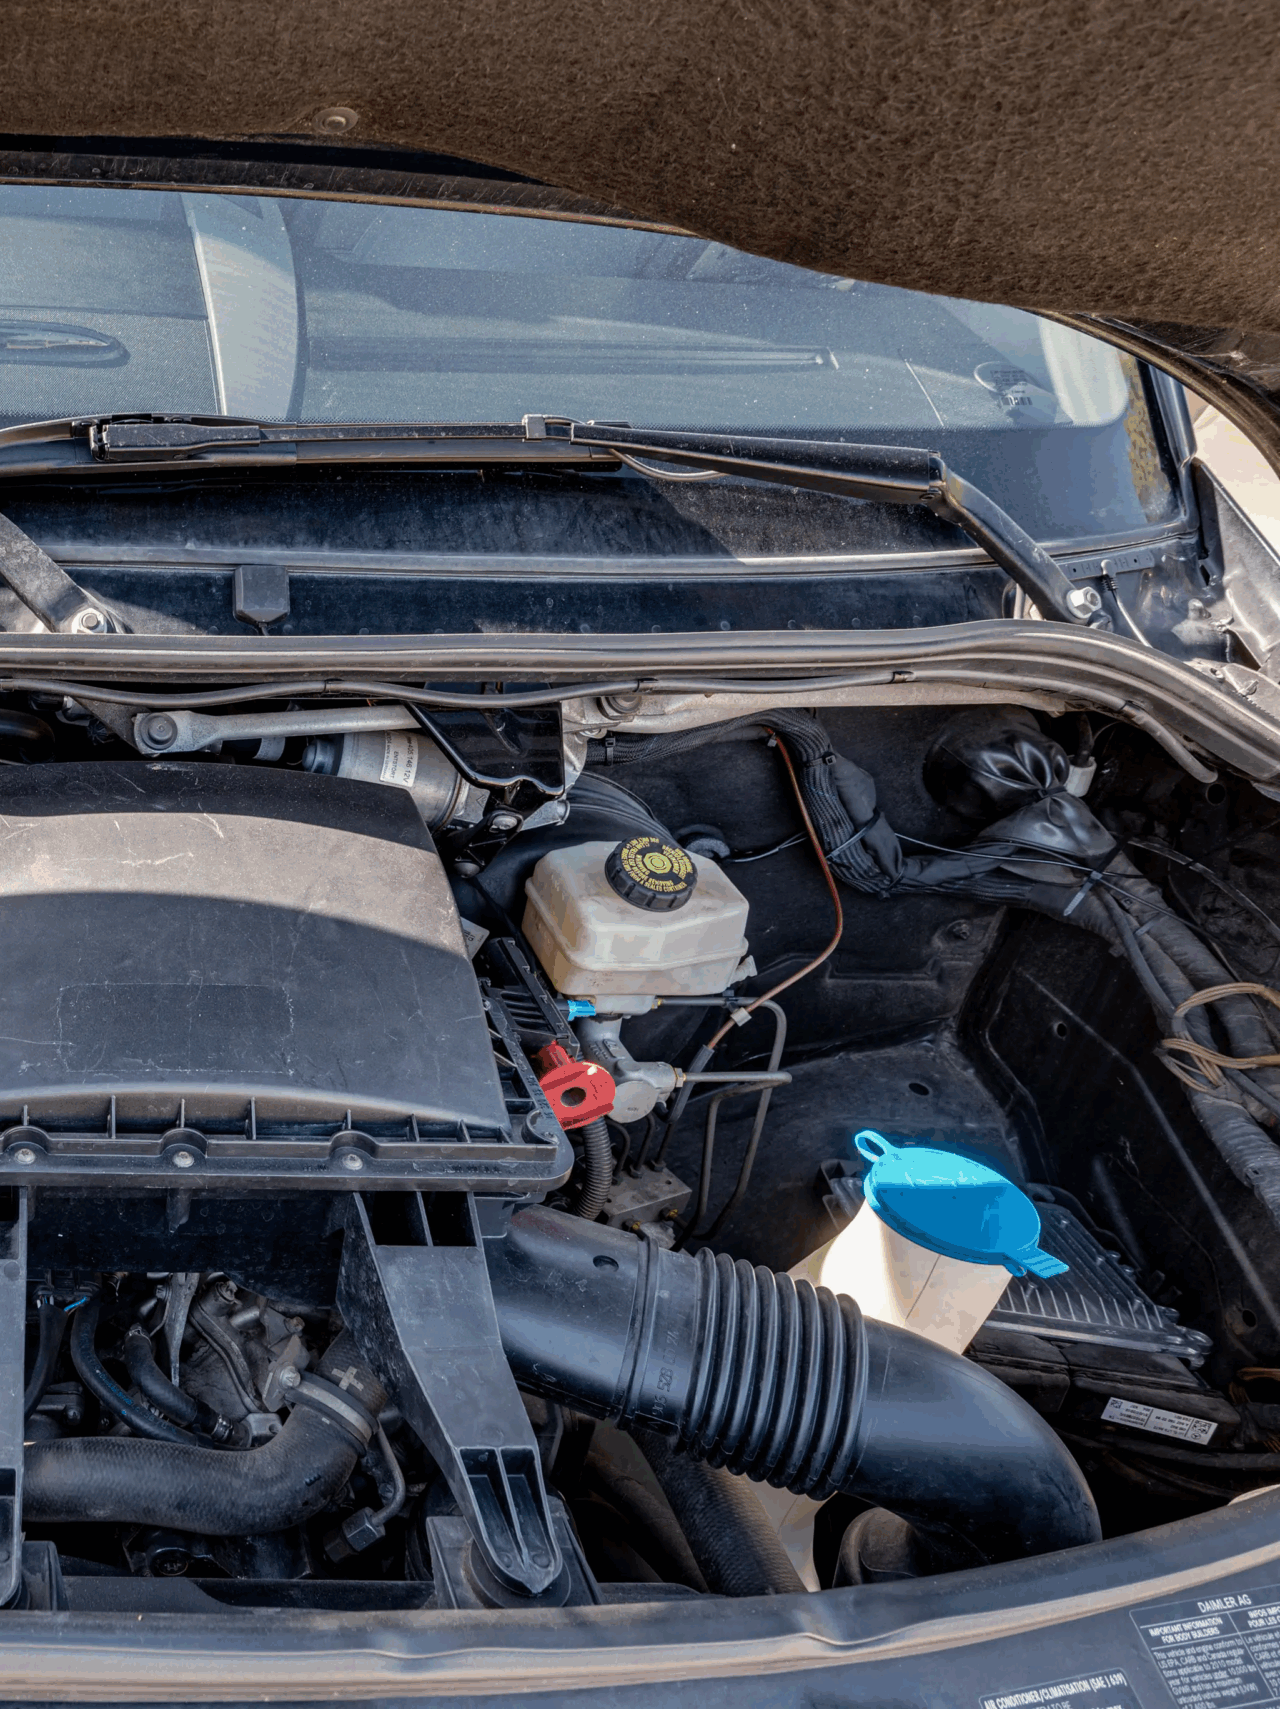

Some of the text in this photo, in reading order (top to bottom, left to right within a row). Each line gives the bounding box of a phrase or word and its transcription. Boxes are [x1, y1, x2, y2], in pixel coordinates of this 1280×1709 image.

[1197, 1594, 1252, 1613] DAIMLER AG
[1149, 1617, 1223, 1637] IMPORTANT INFORMATION
[1161, 1627, 1220, 1644] FOR BODY BUILDERS
